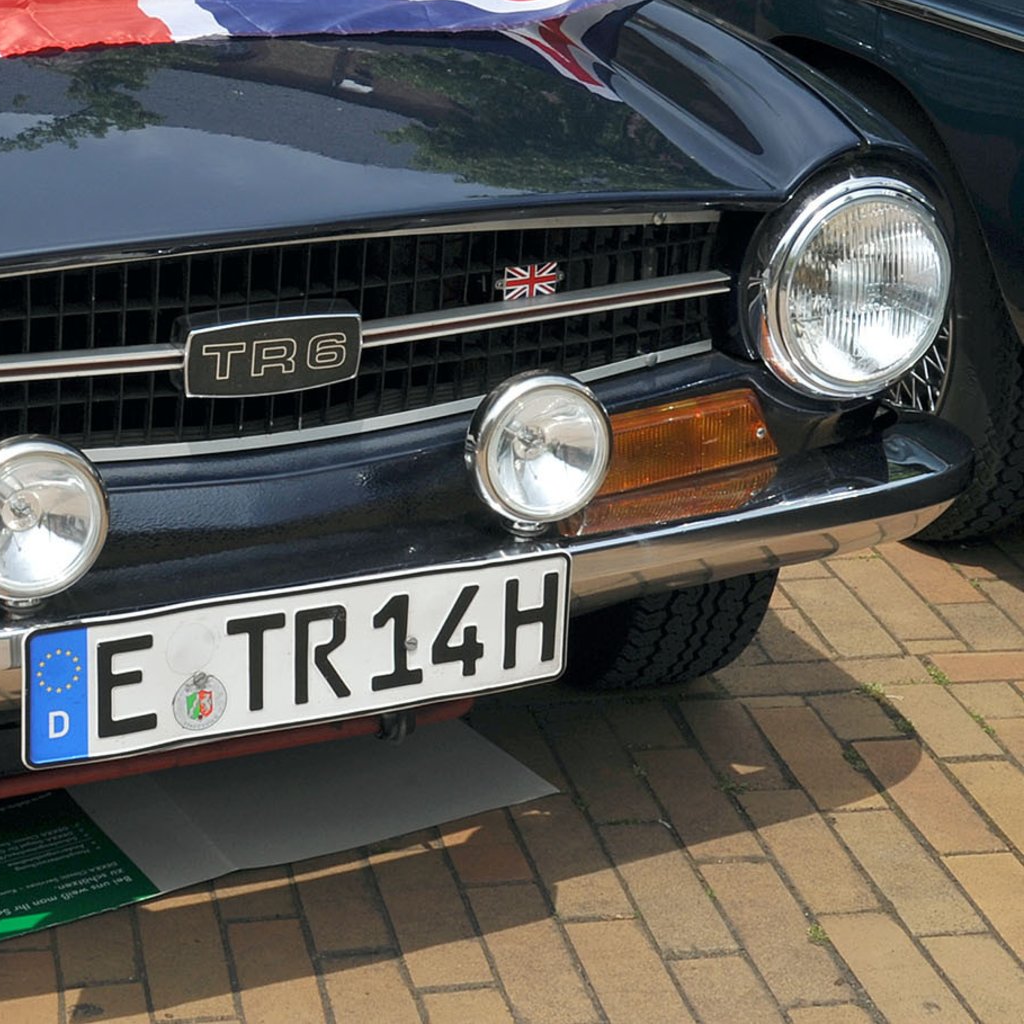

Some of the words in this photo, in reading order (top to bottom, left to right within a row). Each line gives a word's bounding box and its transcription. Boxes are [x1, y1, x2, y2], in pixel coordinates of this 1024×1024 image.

[202, 332, 347, 381] TR6
[97, 634, 158, 739] E
[48, 710, 70, 739] D
